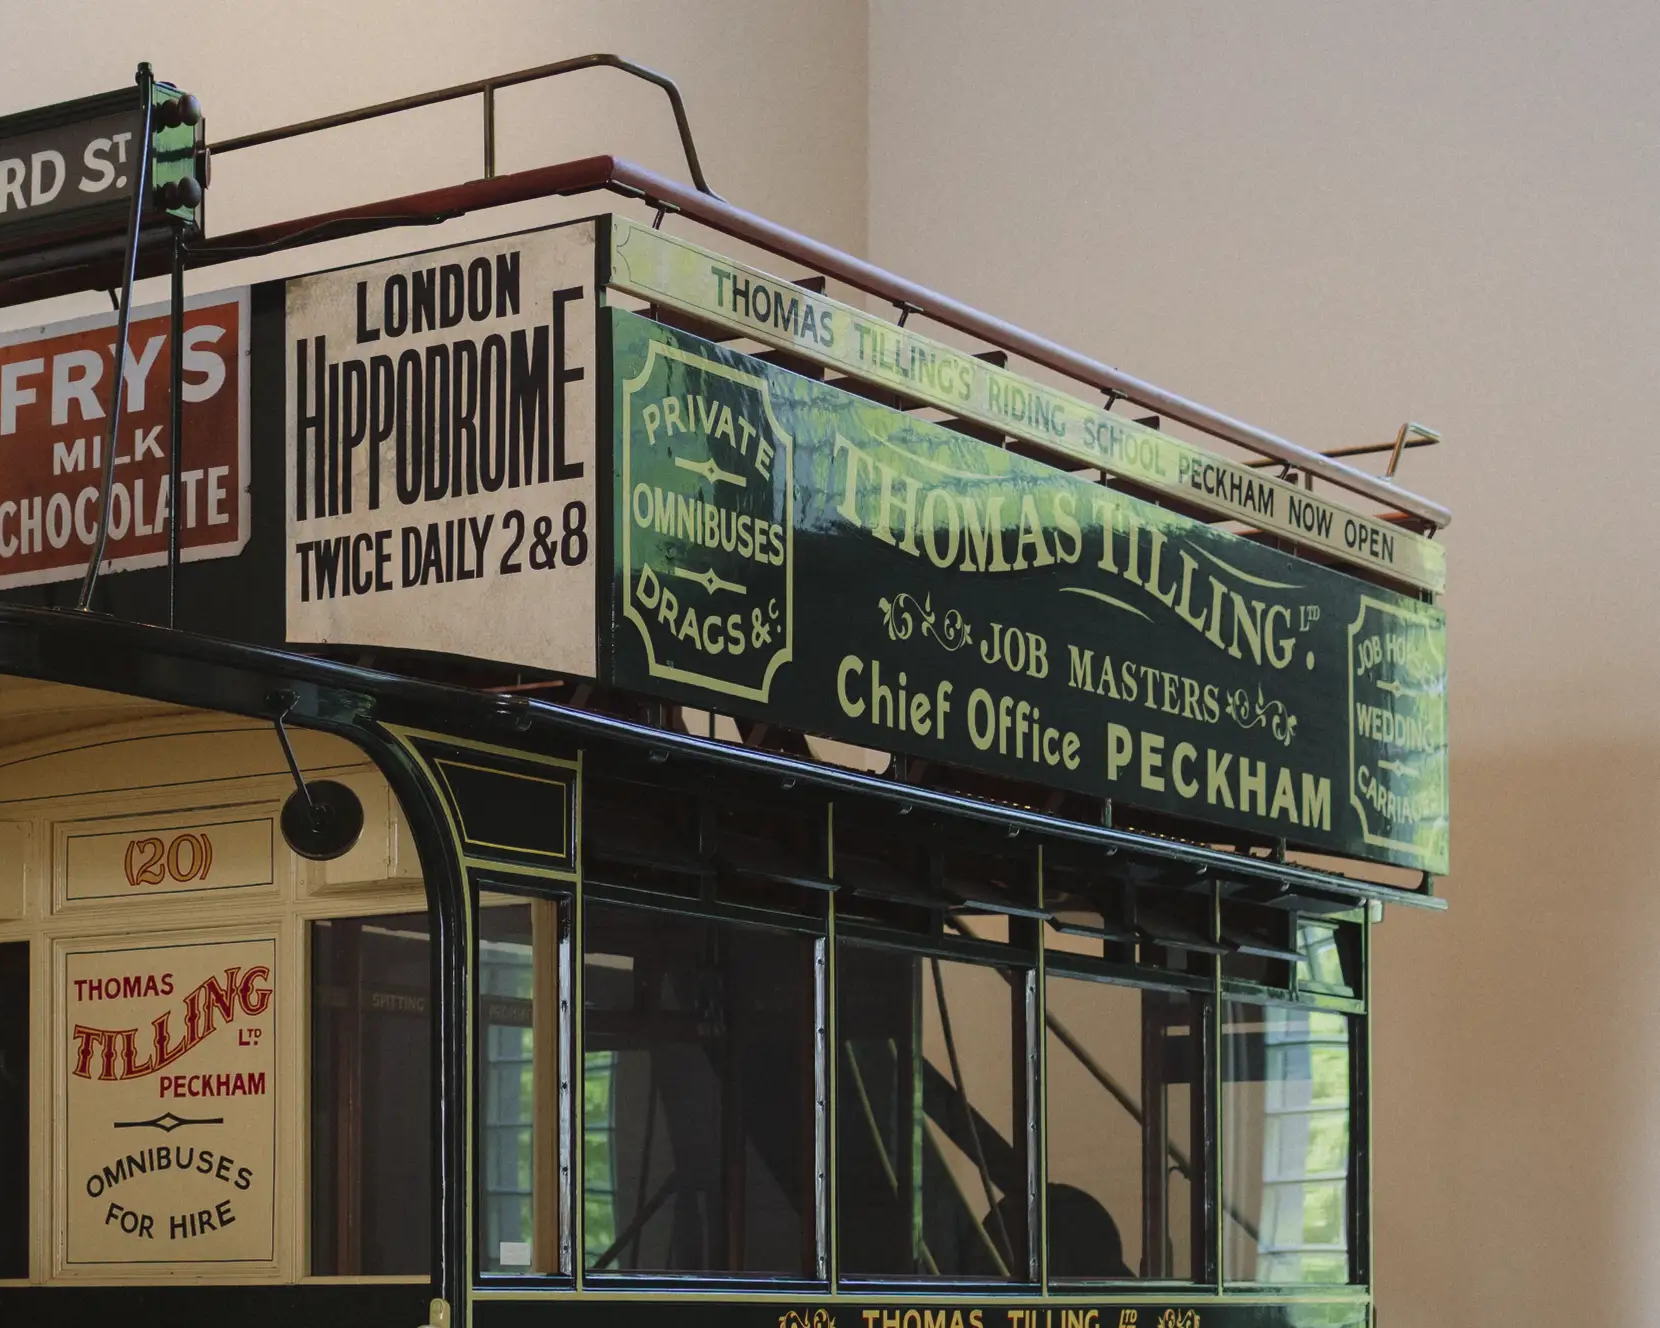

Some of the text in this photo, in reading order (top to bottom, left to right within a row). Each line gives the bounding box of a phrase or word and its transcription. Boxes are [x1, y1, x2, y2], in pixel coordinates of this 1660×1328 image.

[356, 251, 521, 344] LONDON
[296, 286, 584, 522] HIPPODROME
[642, 394, 774, 481] PRIVATE
[711, 266, 835, 348] THOMAS
[987, 376, 1066, 437] RIDING
[1083, 418, 1166, 477] SCHOOL
[1178, 451, 1274, 519] PECKHAM
[1289, 495, 1333, 539] NOW
[1344, 519, 1394, 564] OPEN
[633, 482, 784, 567] OMNIBUSES
[835, 432, 1083, 572] THOMAS
[296, 530, 393, 602] TWICE
[401, 514, 495, 587] DAILY
[635, 562, 746, 655] DRAGS
[980, 623, 1221, 724] JOB MASTERS
[1357, 635, 1383, 676] JOB
[837, 654, 1332, 832] Chief Office PECKHAM
[1356, 702, 1435, 755] WEDDING
[124, 833, 213, 886] (20)
[72, 965, 273, 1082] TILLING
[74, 973, 174, 1002] THOMAS
[159, 1071, 266, 1099] PECKHAM
[86, 1146, 254, 1199] OMNIBUSES
[104, 1199, 236, 1240] FOR HIRE
